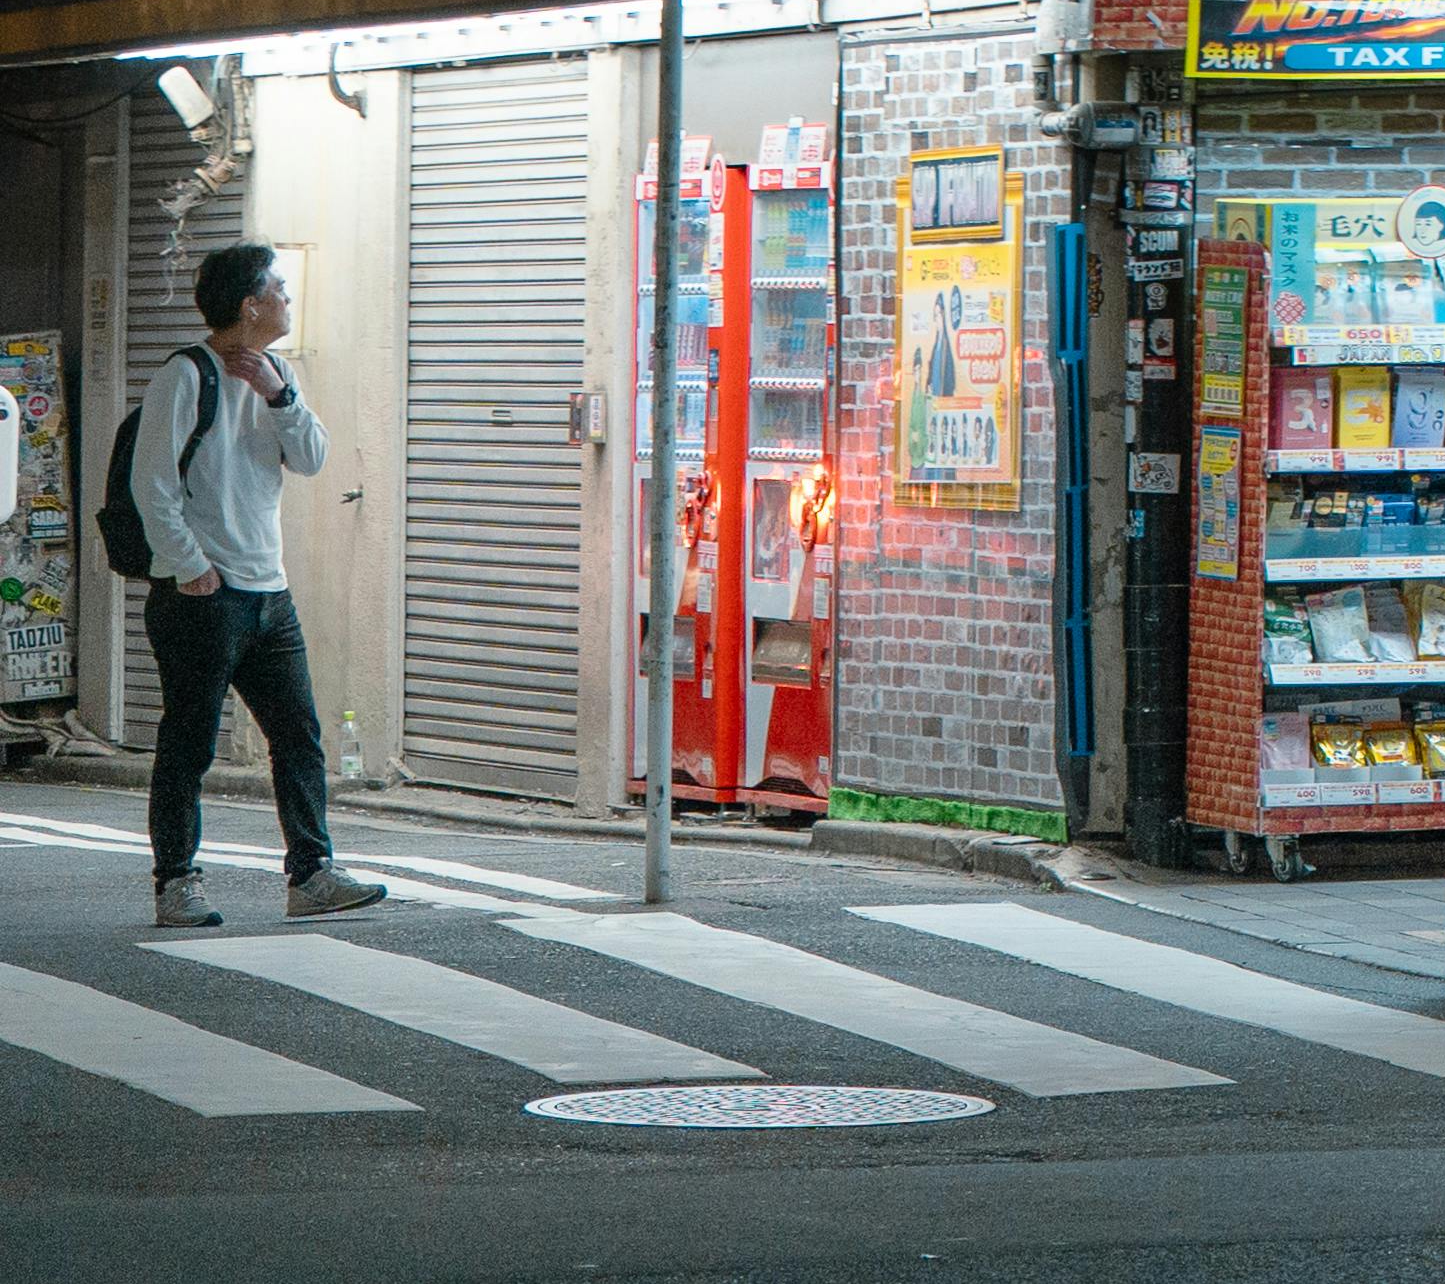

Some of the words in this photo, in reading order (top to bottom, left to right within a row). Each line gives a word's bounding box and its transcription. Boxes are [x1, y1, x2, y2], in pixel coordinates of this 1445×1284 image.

[1327, 47, 1412, 67] TAX
[1320, 214, 1386, 238] 毛穴
[1280, 211, 1299, 287] お米のマスク
[1346, 328, 1381, 339] 650
[1337, 344, 1393, 362] JAPAN
